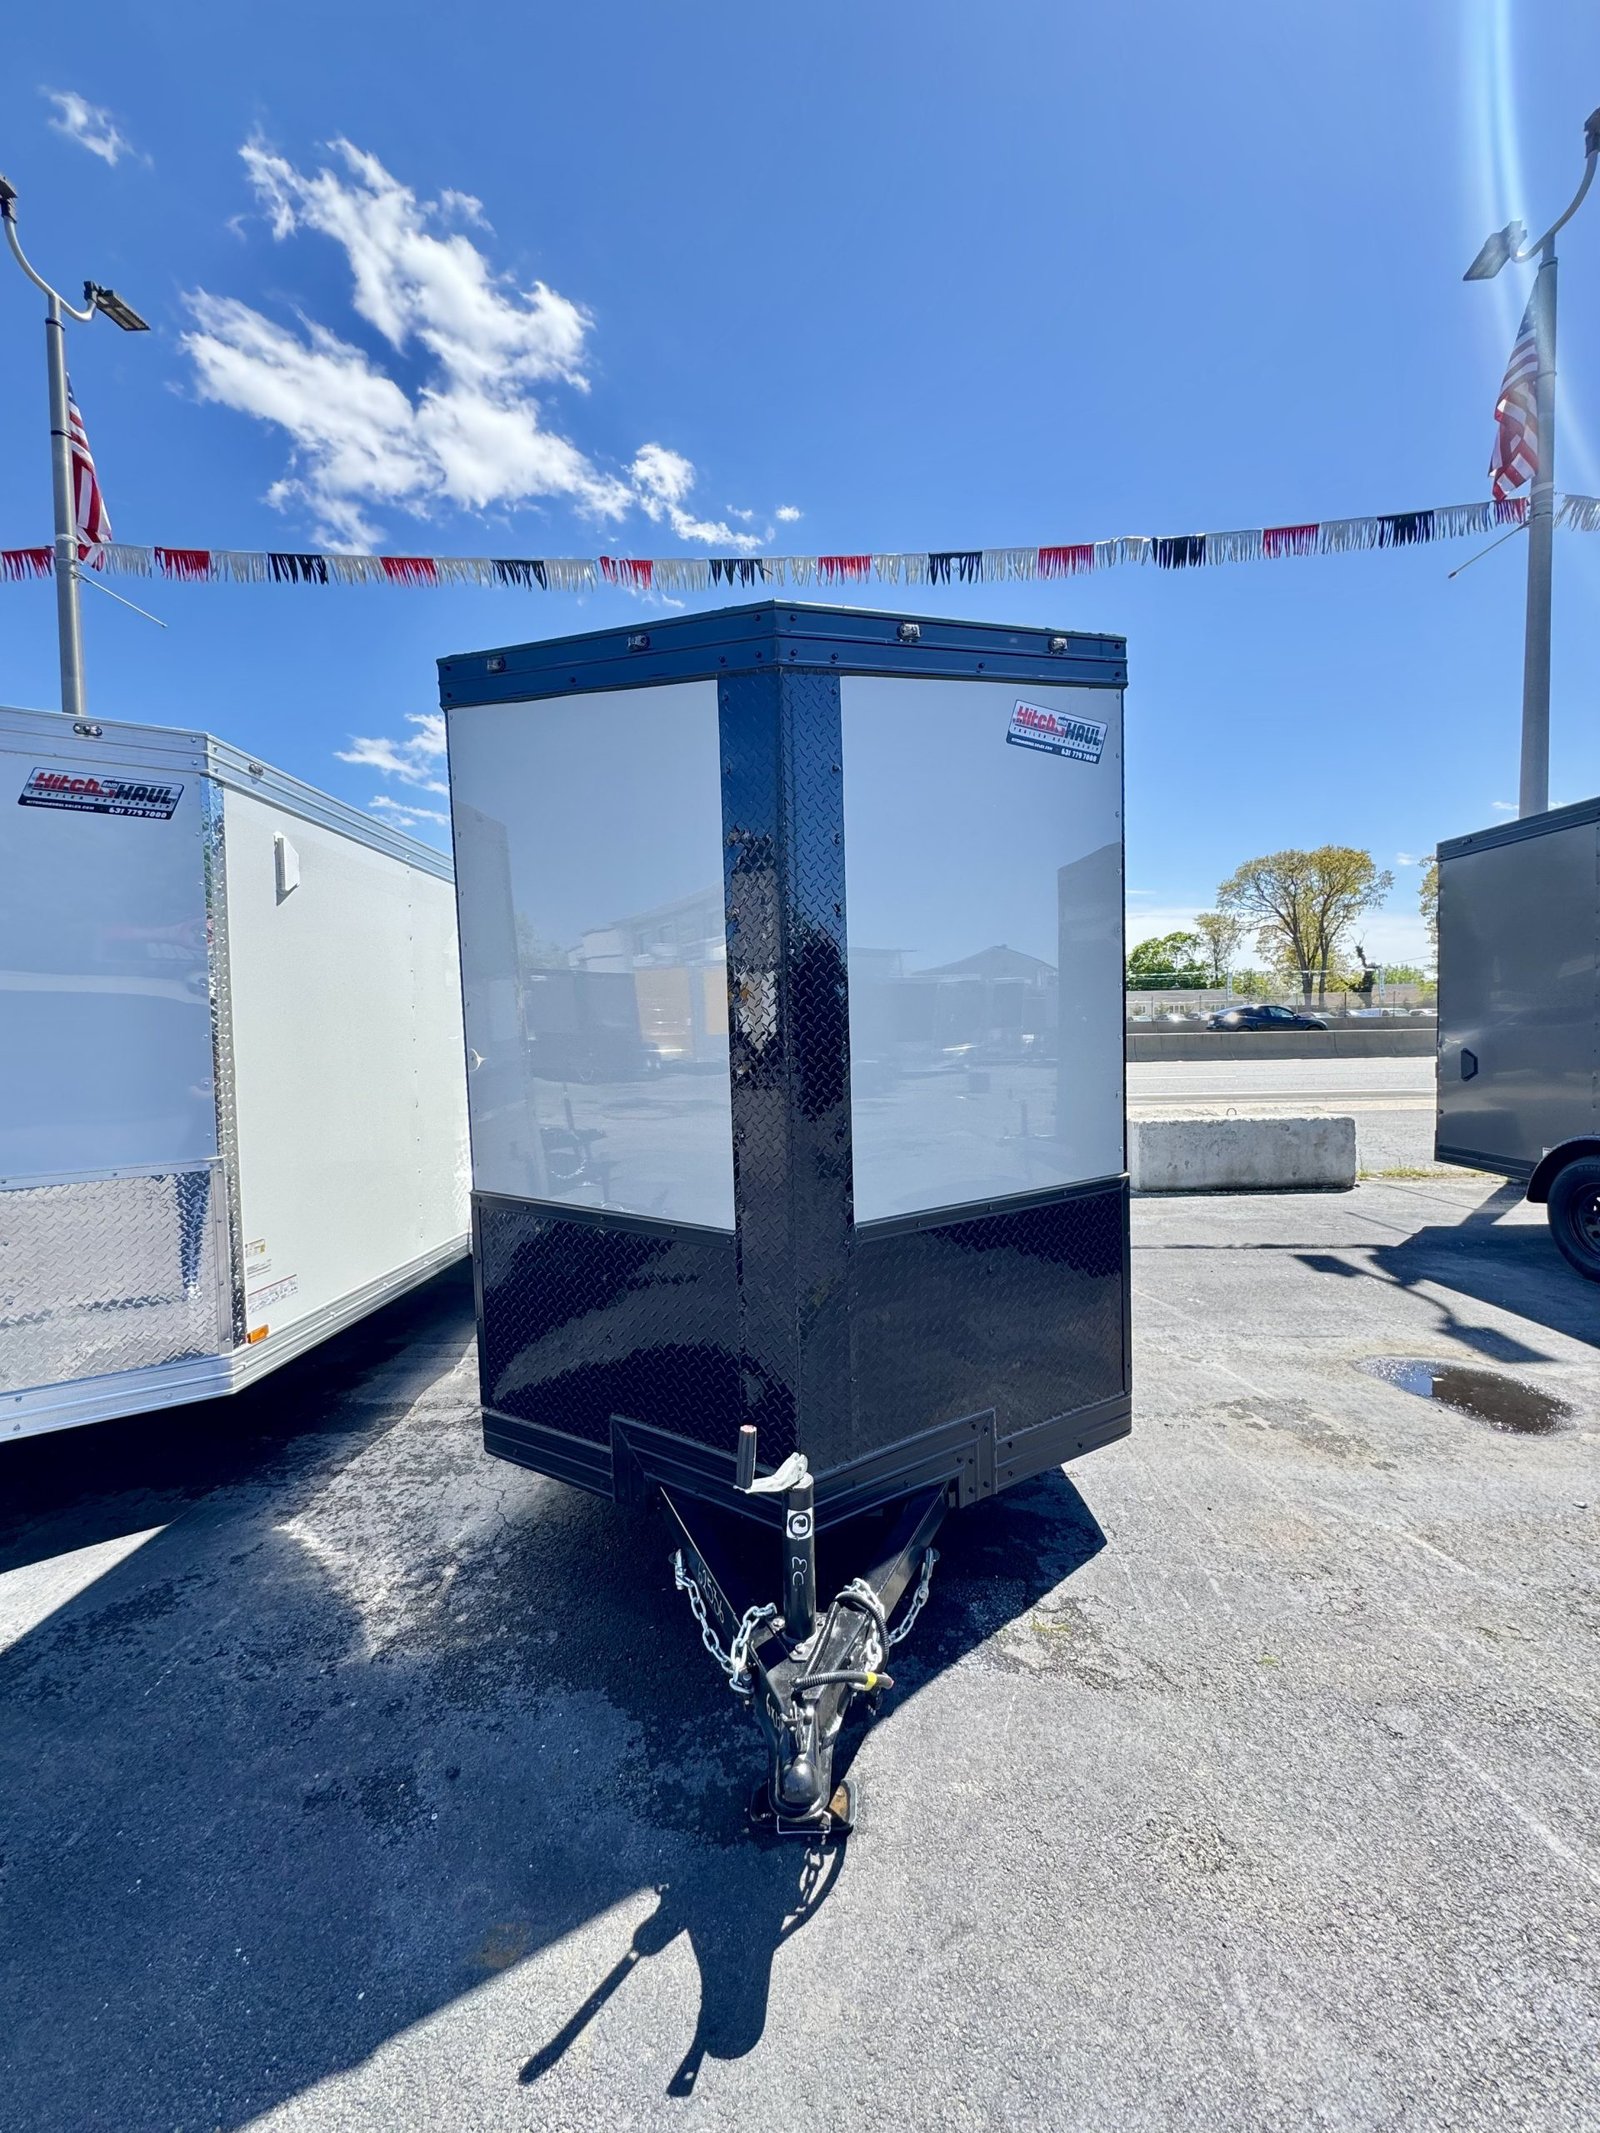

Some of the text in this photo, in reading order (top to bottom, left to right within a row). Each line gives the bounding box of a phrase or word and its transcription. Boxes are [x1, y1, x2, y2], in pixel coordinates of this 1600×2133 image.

[1017, 705, 1057, 732] Hitch
[1065, 722, 1100, 746] HAUL
[33, 772, 102, 795] Hitch
[114, 784, 172, 804] HAUL
[108, 806, 124, 814] 631
[127, 808, 143, 816] 779
[144, 810, 168, 818] 7000
